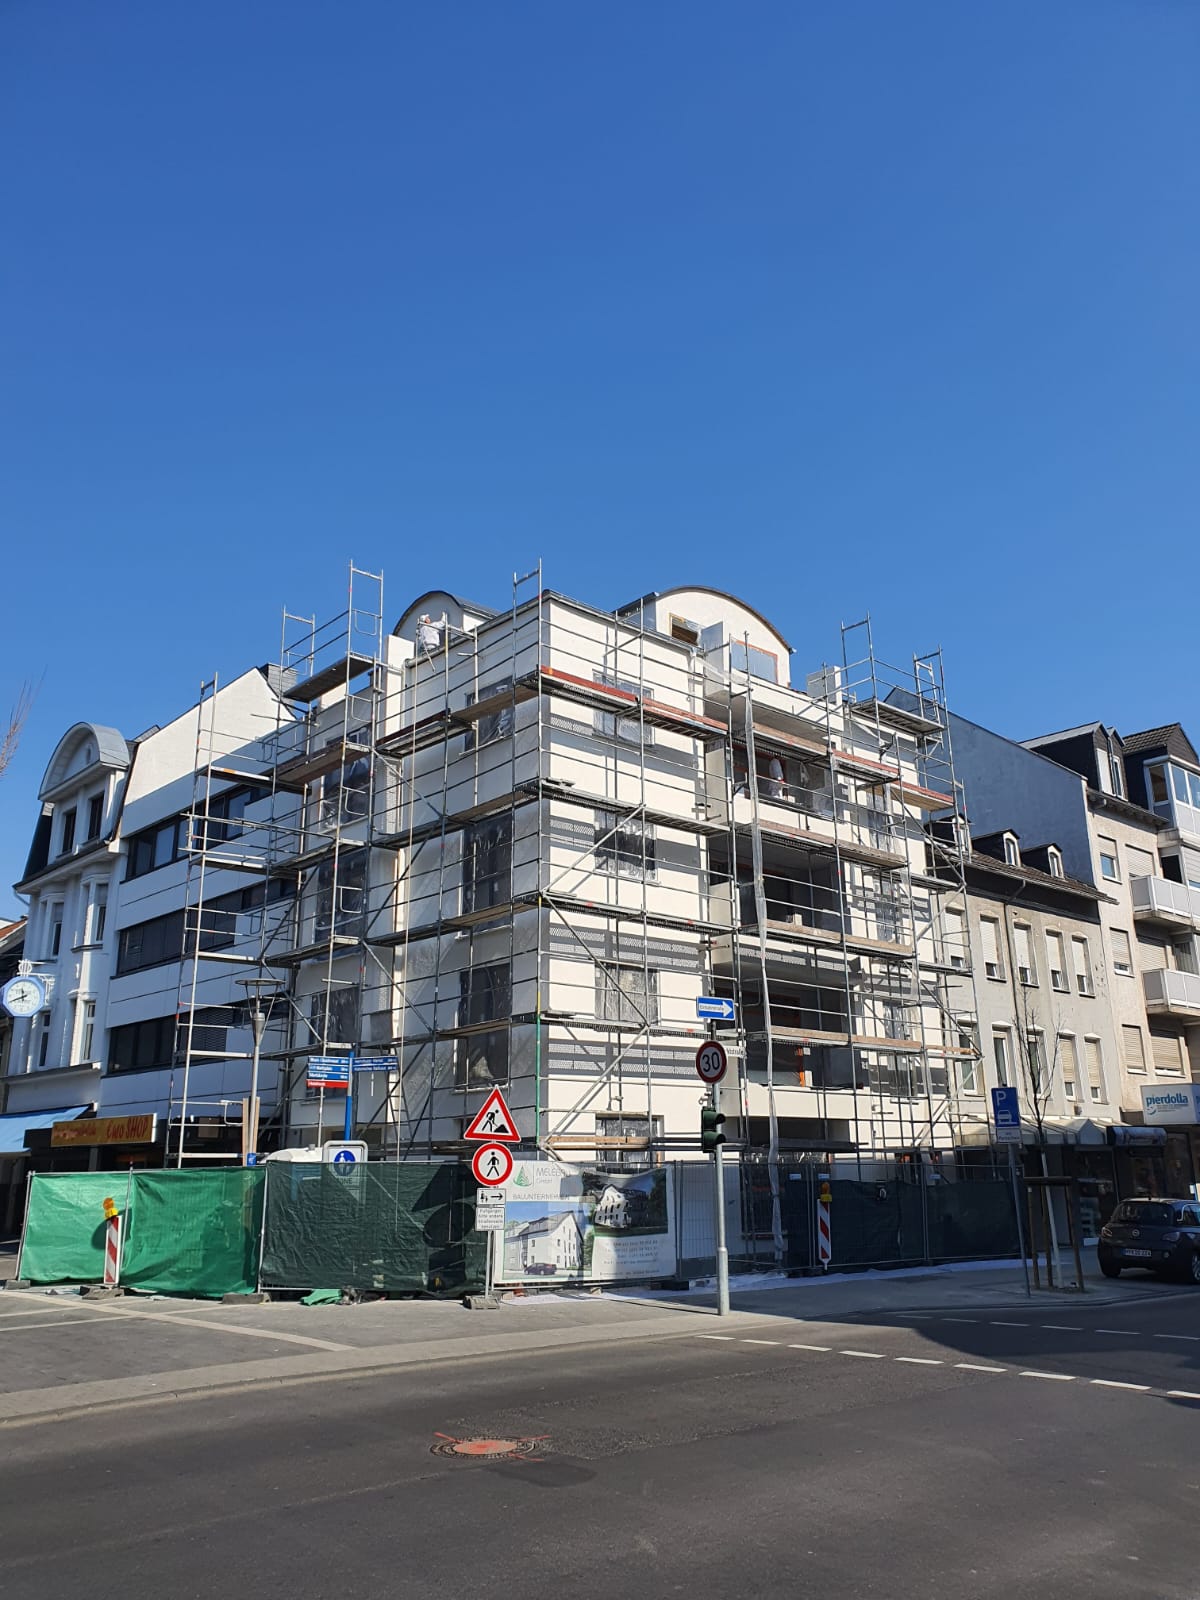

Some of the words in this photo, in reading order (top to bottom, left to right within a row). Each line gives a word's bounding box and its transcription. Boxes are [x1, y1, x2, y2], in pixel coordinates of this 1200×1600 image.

[702, 1051, 720, 1073] 30
[996, 1090, 1007, 1106] P
[1146, 1092, 1189, 1107] pierdolla
[126, 1116, 149, 1139] SHOP
